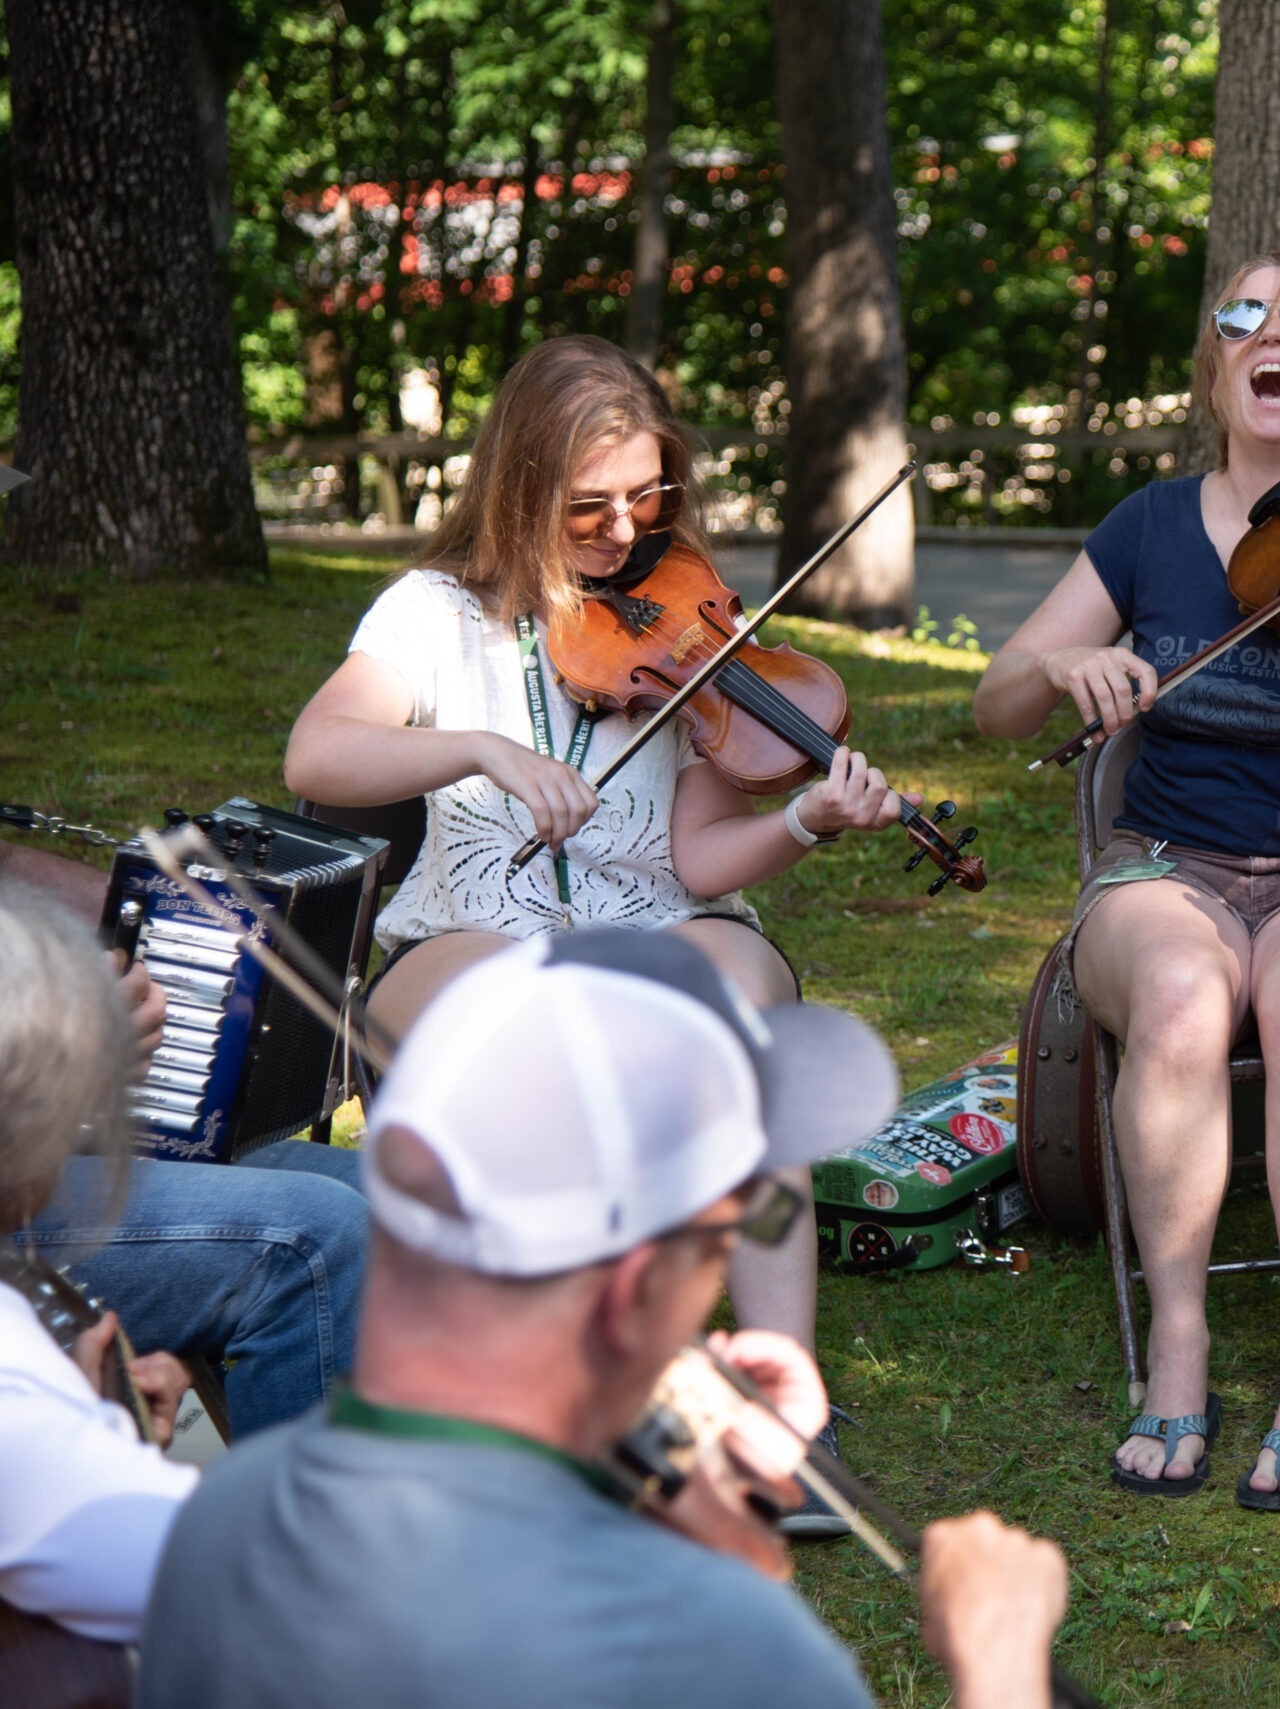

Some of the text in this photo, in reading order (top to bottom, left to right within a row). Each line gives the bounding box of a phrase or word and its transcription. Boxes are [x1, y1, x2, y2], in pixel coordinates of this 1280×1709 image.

[1155, 657, 1188, 667] ROOT
[1203, 662, 1238, 673] USIC
[526, 669, 549, 756] AUGUSTA HERITAG
[569, 719, 591, 770] USTA HERIT
[156, 899, 191, 911] BON
[193, 902, 241, 926] TEMPS
[893, 1137, 938, 1164] THE
[906, 1125, 972, 1161] GOOD
[912, 1138, 962, 1168] WAY
